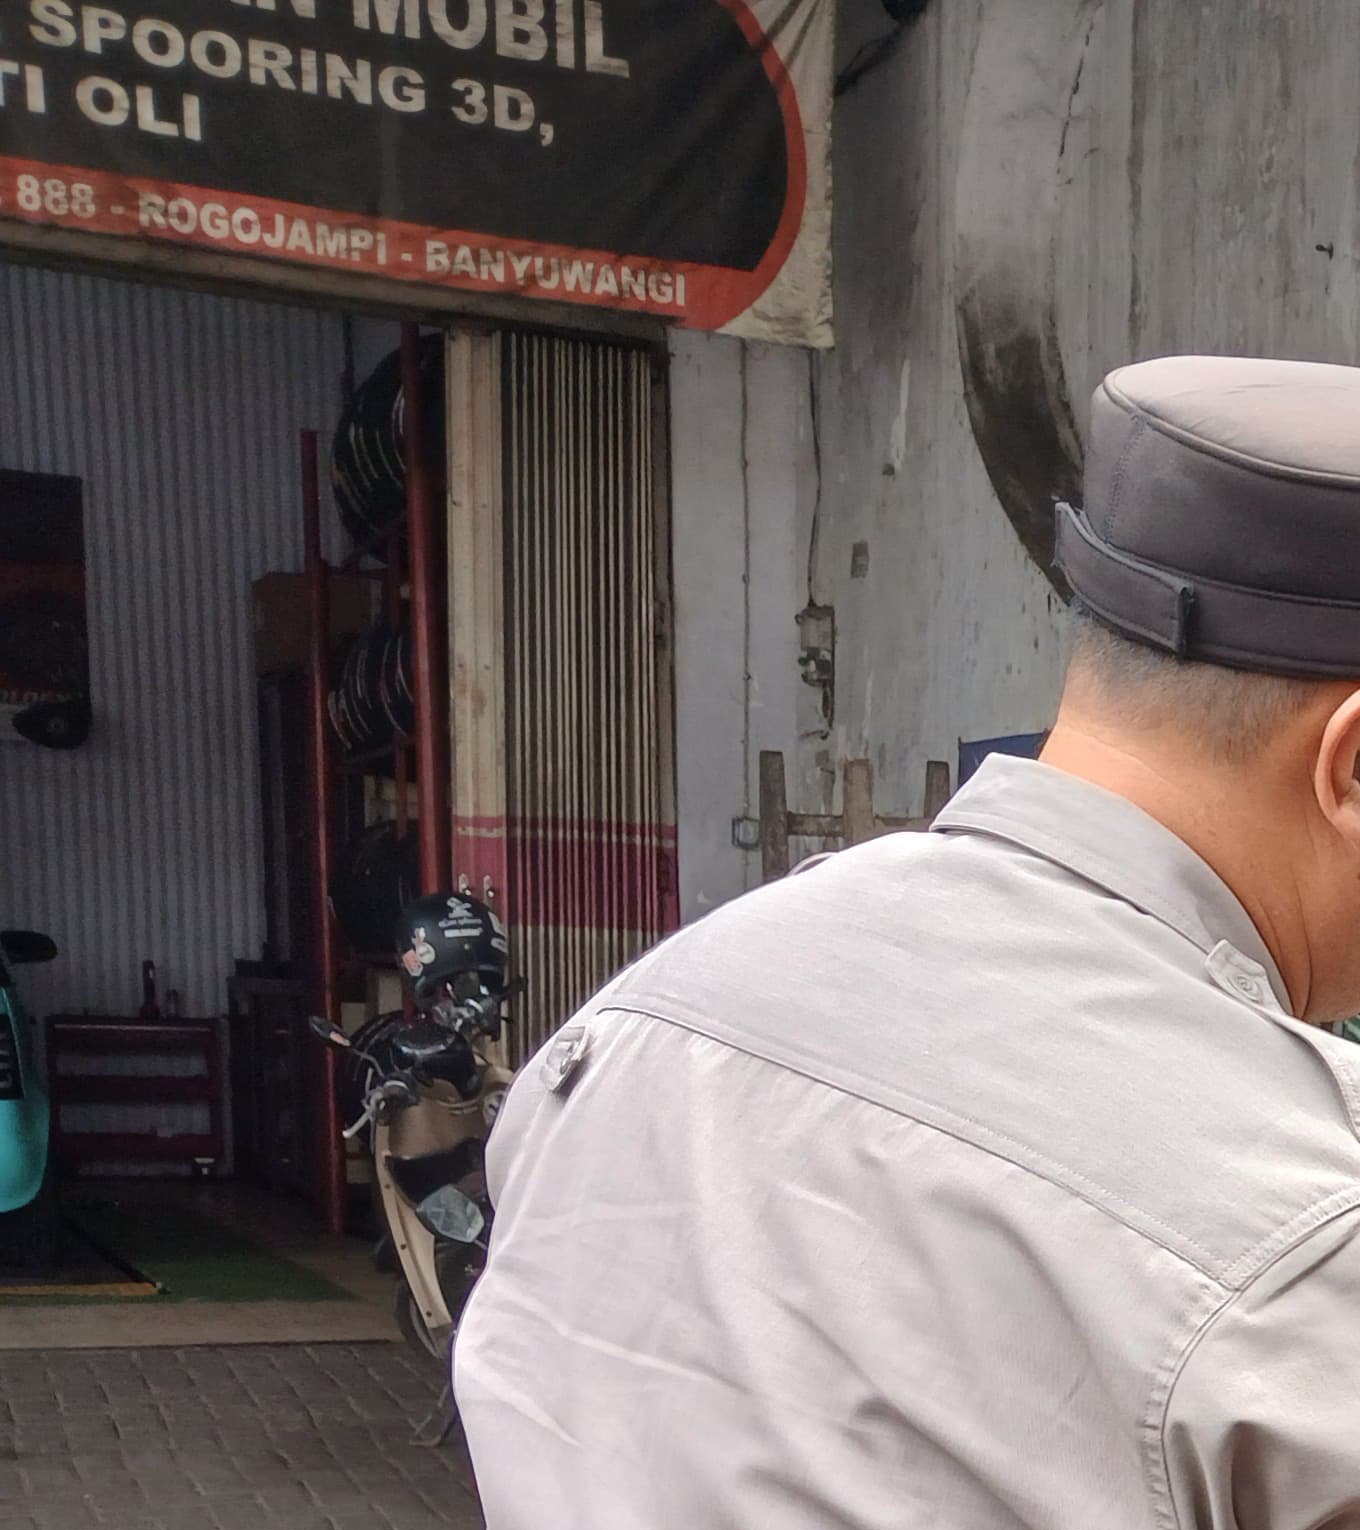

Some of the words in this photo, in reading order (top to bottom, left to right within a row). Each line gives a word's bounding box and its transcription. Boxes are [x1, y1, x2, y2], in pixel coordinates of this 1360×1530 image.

[29, 0, 427, 113] SPOORING
[451, 77, 556, 147] 3D,
[353, 0, 630, 78] MOBIL
[75, 75, 202, 141] OLI
[16, 173, 96, 218] 888
[138, 191, 388, 266] ROGOJAMPI
[425, 238, 686, 307] BANYUWANGI
